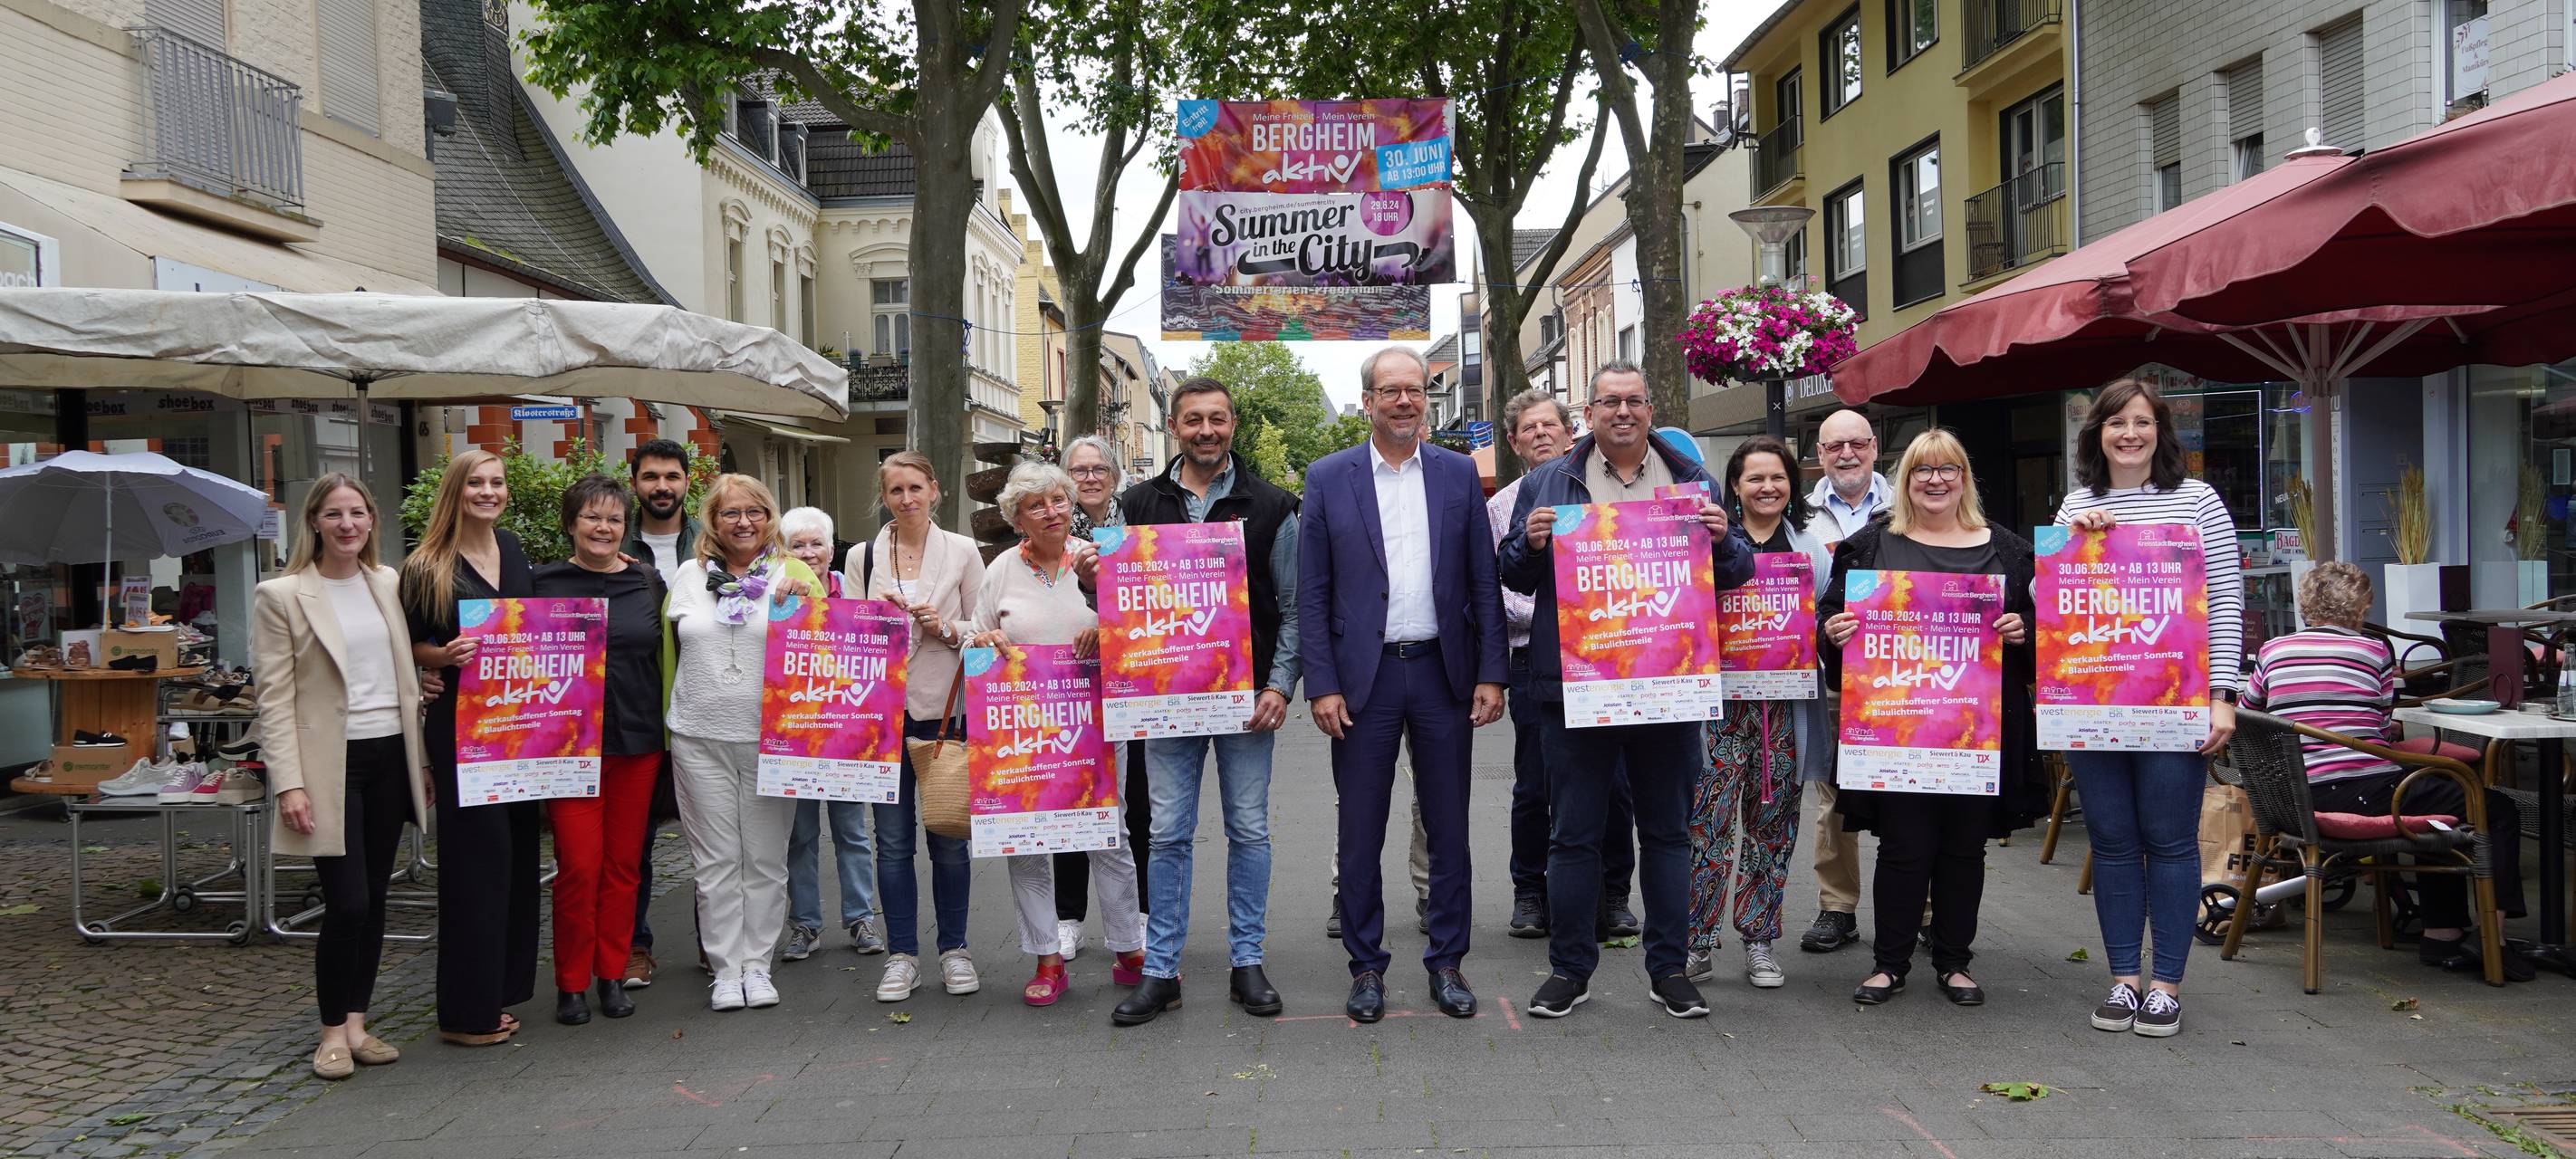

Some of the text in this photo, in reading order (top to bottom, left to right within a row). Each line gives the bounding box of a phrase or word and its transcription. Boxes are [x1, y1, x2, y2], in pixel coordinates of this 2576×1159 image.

[2461, 38, 2488, 54] Fußpfleg
[2462, 60, 2489, 72] Manikür
[1182, 105, 1209, 127] Eintritt
[1253, 112, 1375, 121] Meine Freizeit Mein Verein
[1253, 123, 1375, 152] BERGHEIM
[1384, 143, 1444, 168] 30. JUNI
[1263, 151, 1362, 184] aktiv
[1387, 162, 1446, 182] AB 13:00 UHR
[1211, 204, 1355, 247] Summer
[1373, 212, 1399, 222] 18 UHR
[1253, 239, 1296, 257] in the
[1298, 234, 1373, 281] City
[1800, 372, 1833, 398] DELUXE
[87, 400, 125, 415] oebox
[158, 395, 215, 410] shoebox
[513, 407, 575, 418] Klosterstraße
[1576, 536, 1688, 553] 30.06.2024 AB 13 UHR
[2276, 532, 2301, 551] BAGD
[1576, 550, 1688, 563] Meine Freizeit Mein Verein
[1116, 558, 1225, 574] 30.06.2024 AB 13 UHR
[2058, 561, 2182, 575] 30.06.2024 AB 13 UHR
[1143, 573, 1172, 581] Freizeit
[1576, 560, 1692, 592] BERGHEIM
[2058, 576, 2181, 585] Meine Freizeit Mein Verein
[1117, 581, 1227, 612] BERGHEIM
[1589, 587, 1681, 623] aktiv
[1723, 594, 1800, 613] BERGHEIM
[2058, 587, 2183, 615] BERGHEIM
[1129, 607, 1217, 639] aktiv
[1730, 611, 1792, 633] aktiv
[1866, 610, 1981, 624] 30.06.2024 AB 13 UHR
[786, 628, 889, 645] 30.06.2024 AB 13 UHR
[1589, 621, 1696, 641] verkaufsoffener Sonntag
[1893, 623, 1923, 632] Freizeit
[1953, 626, 1980, 634] Verein
[2068, 614, 2170, 645] aktiv
[483, 632, 586, 645] 30.06.2024 AB 13 UHR
[1591, 637, 1652, 652] Blaulichtmeile
[811, 643, 837, 651] Freizeit
[842, 645, 860, 653] Mein
[863, 647, 888, 655] Verein
[1129, 639, 1230, 658] verkaufsoffener Sonntag
[1864, 634, 1980, 662] BERGHEIM
[1129, 655, 1188, 668] Blaulichtmeile
[2067, 650, 2184, 665] verkaufsoffener Sonntag
[479, 654, 585, 680] BERGHEIM
[783, 652, 888, 681] BERGHEIM
[1872, 660, 1967, 690] aktiv
[2068, 665, 2135, 675] Blaulichtmeile
[789, 677, 875, 706] aktiv
[985, 678, 1091, 694] 30.06.2024 AB 13 UHR
[1871, 696, 1978, 706] verkaufsoffener Sonntag
[549, 708, 582, 717] Sonntag
[787, 712, 884, 721] verkaufsoffener Sonntag
[987, 701, 1092, 730] BERGHEIM
[1871, 708, 1935, 716] Blaulichtmeile
[997, 725, 1083, 759] aktiv
[996, 757, 1095, 776] verkaufsoffener Sonntag
[997, 772, 1056, 786] Blaulichtmeile
